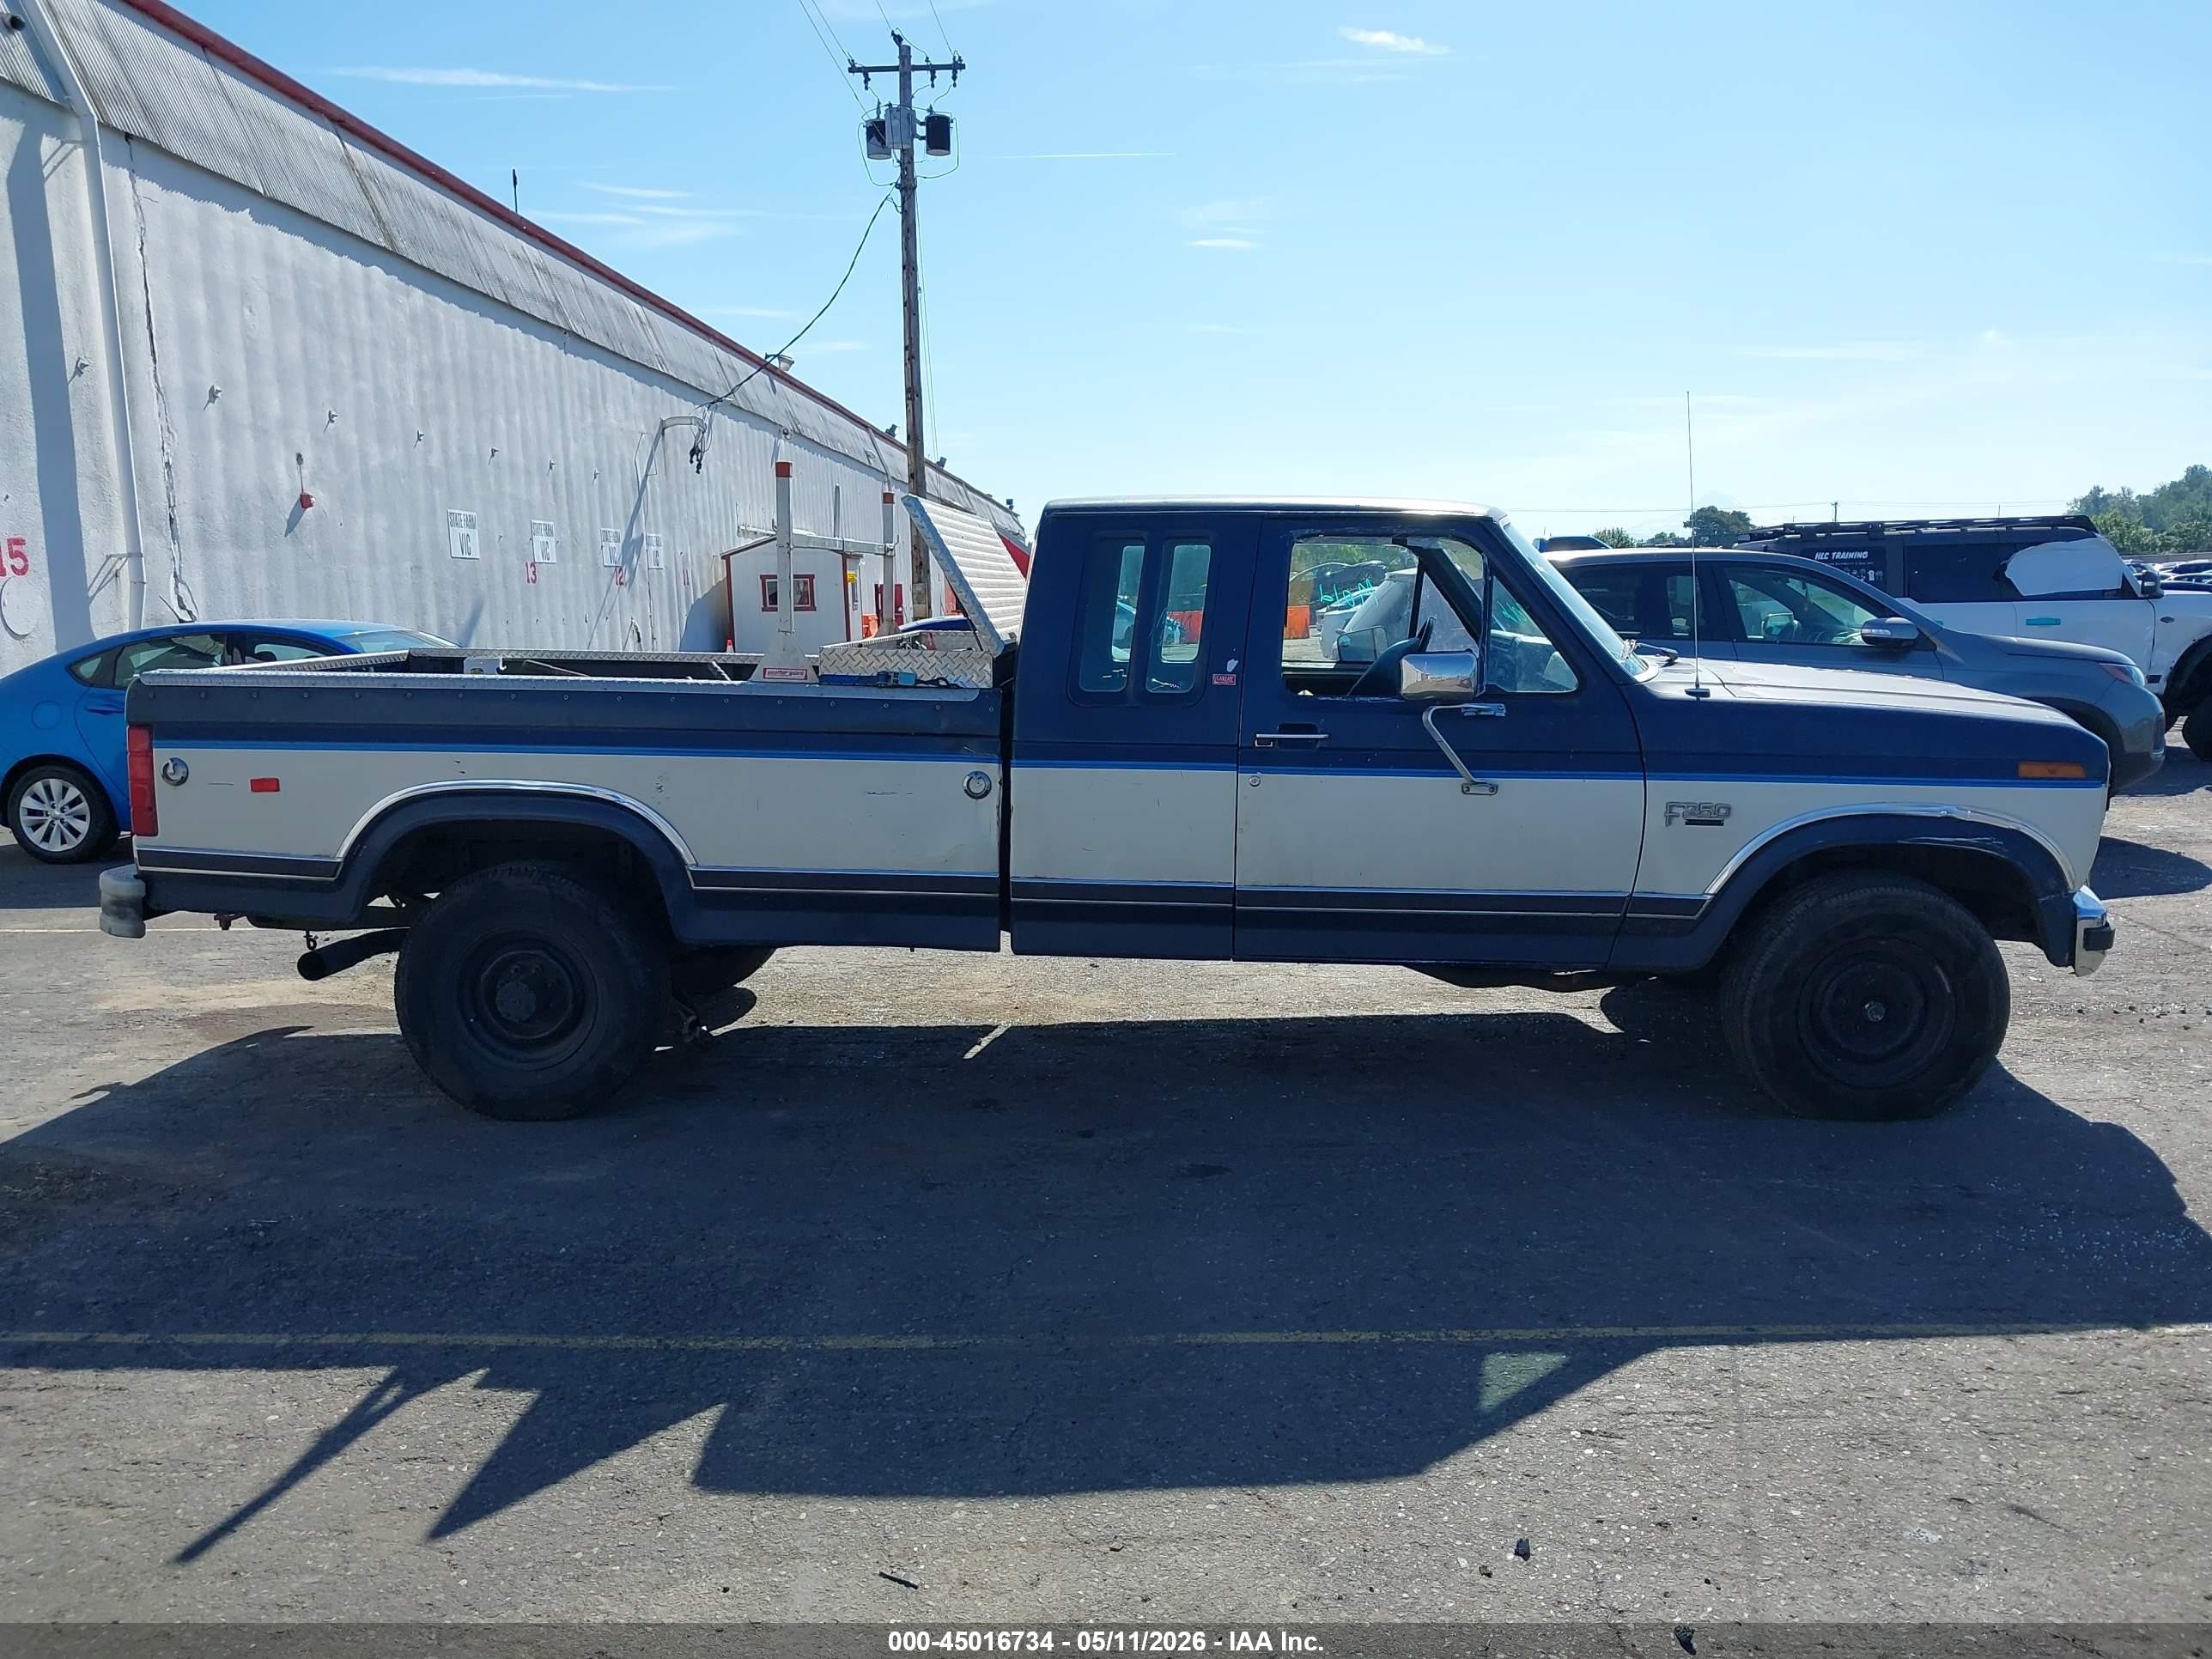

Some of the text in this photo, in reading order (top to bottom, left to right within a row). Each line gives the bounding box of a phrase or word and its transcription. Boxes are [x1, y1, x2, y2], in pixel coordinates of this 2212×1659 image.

[449, 512, 477, 529] STATE FARM
[459, 532, 471, 556] VIC
[1832, 550, 1869, 560] TRAINING
[525, 562, 537, 584] 13
